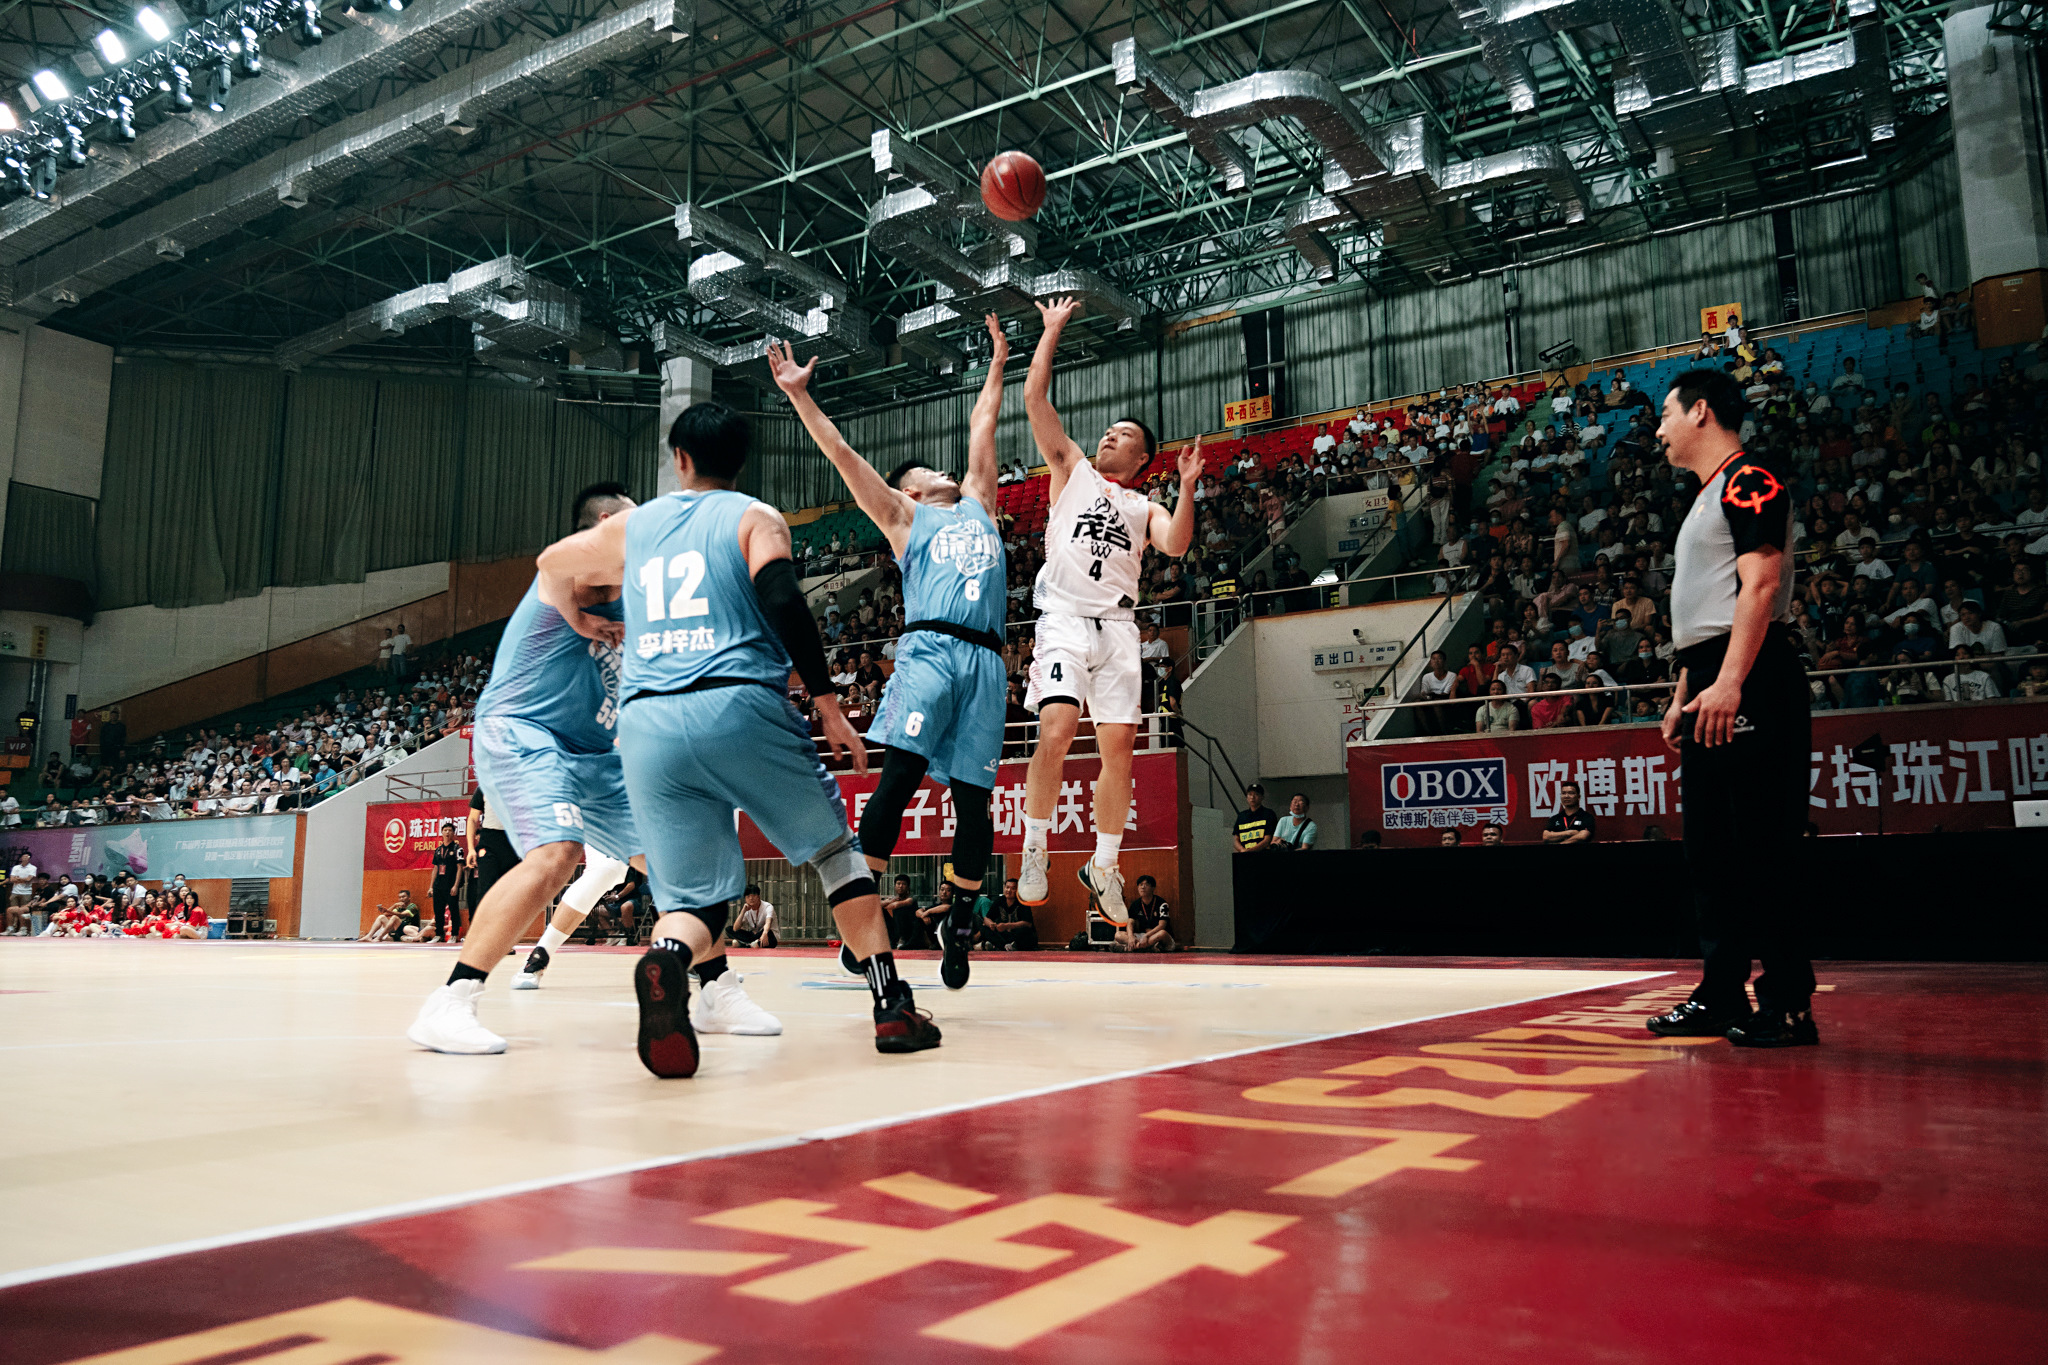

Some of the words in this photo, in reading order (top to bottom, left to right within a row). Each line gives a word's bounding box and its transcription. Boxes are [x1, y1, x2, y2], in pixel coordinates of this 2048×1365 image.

[1089, 560, 1102, 581] 4
[639, 550, 710, 622] 12
[964, 579, 980, 601] 6
[637, 626, 716, 657] 李梓杰
[1314, 650, 1353, 667] 西出口
[1051, 662, 1063, 682] 4
[595, 697, 618, 731] 55
[905, 711, 924, 737] 6
[9, 742, 27, 750] VIP
[1528, 755, 1682, 818] 欧博斯
[553, 803, 584, 829] 55
[1384, 811, 1428, 828] 欧博斯
[1432, 808, 1508, 826] 箱伴每一天
[414, 839, 437, 852] PEARL
